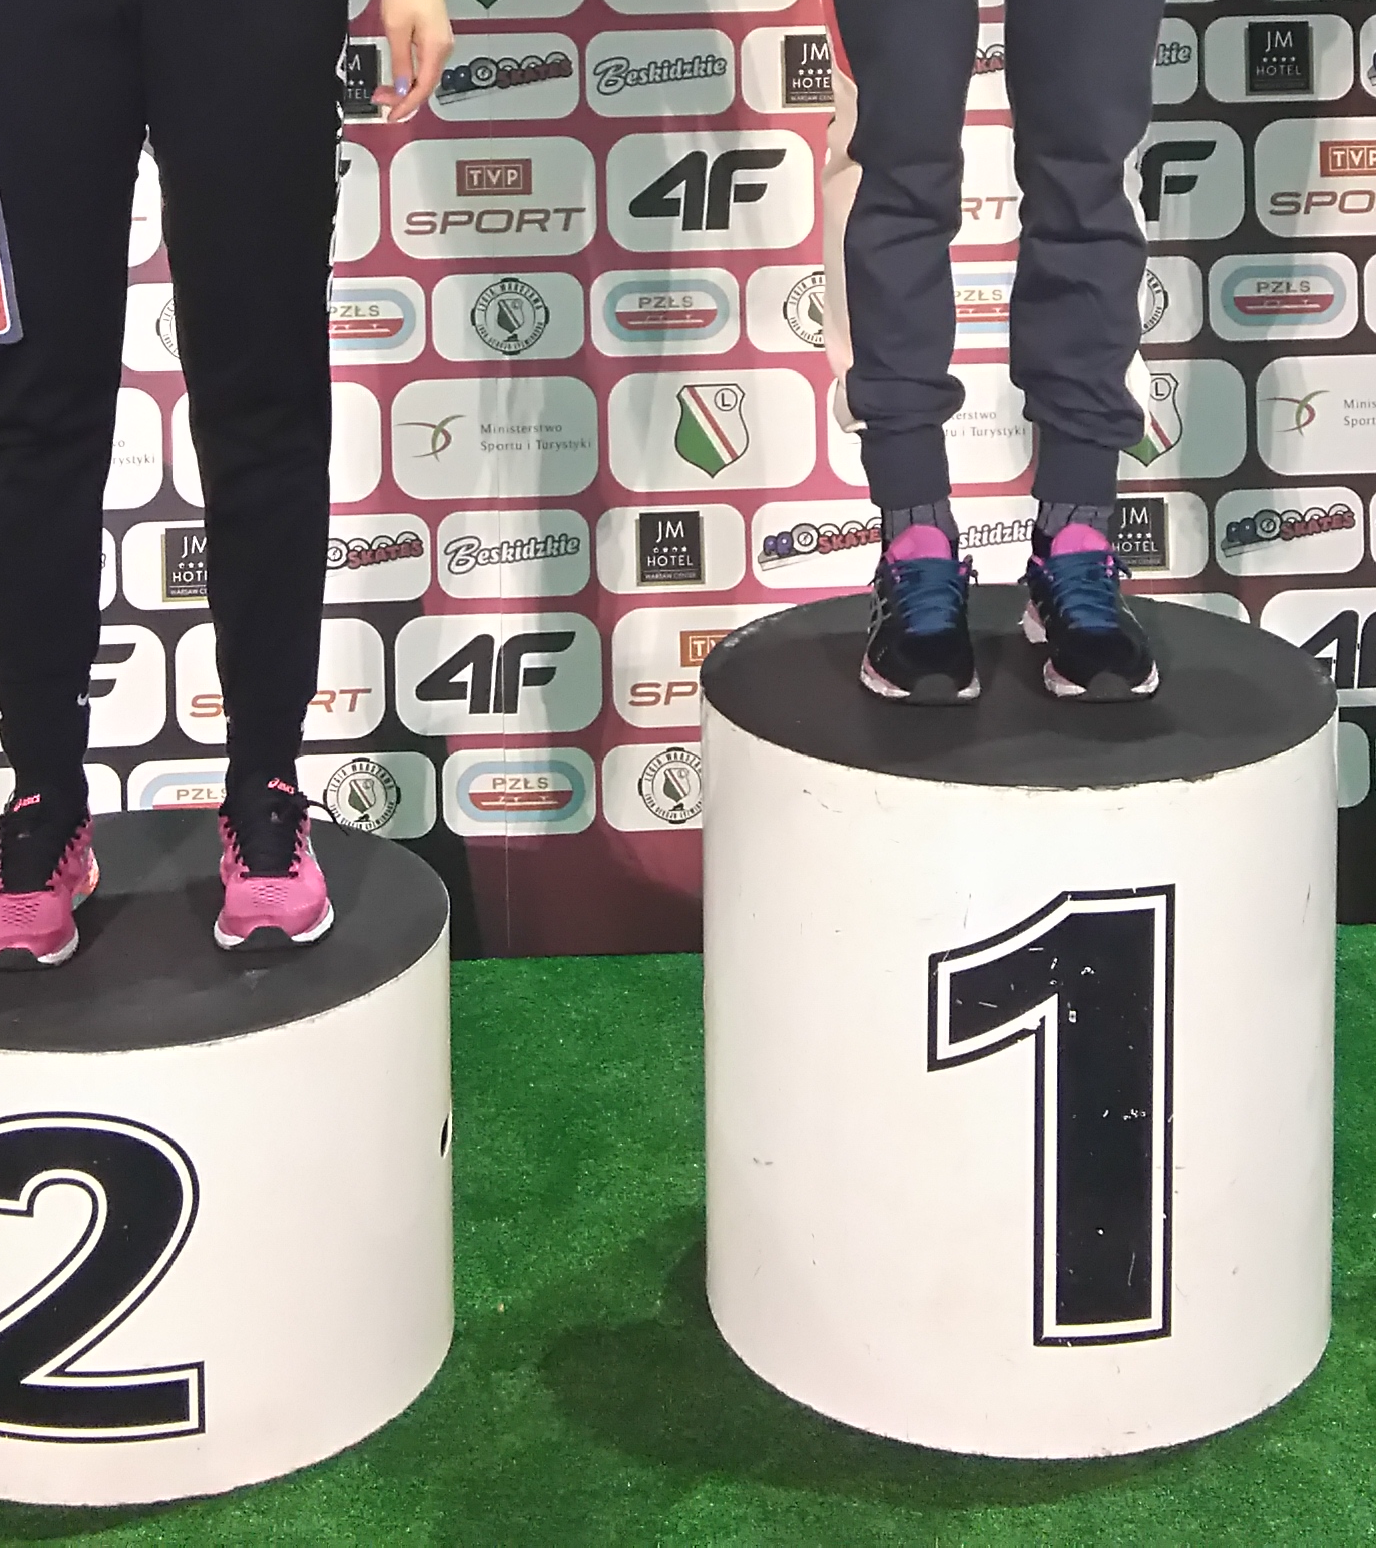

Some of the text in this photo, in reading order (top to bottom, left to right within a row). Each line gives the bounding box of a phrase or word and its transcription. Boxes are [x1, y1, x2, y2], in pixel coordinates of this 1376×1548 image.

[1265, 30, 1293, 52] JM
[800, 42, 829, 65] JM
[593, 55, 728, 96] Beskidzkie
[1256, 64, 1302, 76] HOTEL
[792, 76, 831, 89] HOTE
[466, 169, 522, 191] TVP
[628, 148, 787, 232] 4F
[404, 207, 586, 236] SPORT
[1256, 279, 1312, 294] PZŁS
[637, 294, 694, 309] PZŁS
[480, 422, 563, 435] Ministerstwo
[480, 439, 522, 453] Sportu
[535, 437, 592, 452] Turystyki
[1120, 506, 1149, 529] JM
[655, 520, 684, 543] JM
[817, 528, 881, 553] SKATE
[181, 535, 208, 559] JM
[443, 534, 581, 575] Beskidzkie
[1111, 540, 1159, 552] HOTEL
[647, 554, 694, 567] HOTEL
[415, 631, 577, 715] 4F
[491, 775, 550, 791] PZŁS
[927, 884, 1176, 1347] 1
